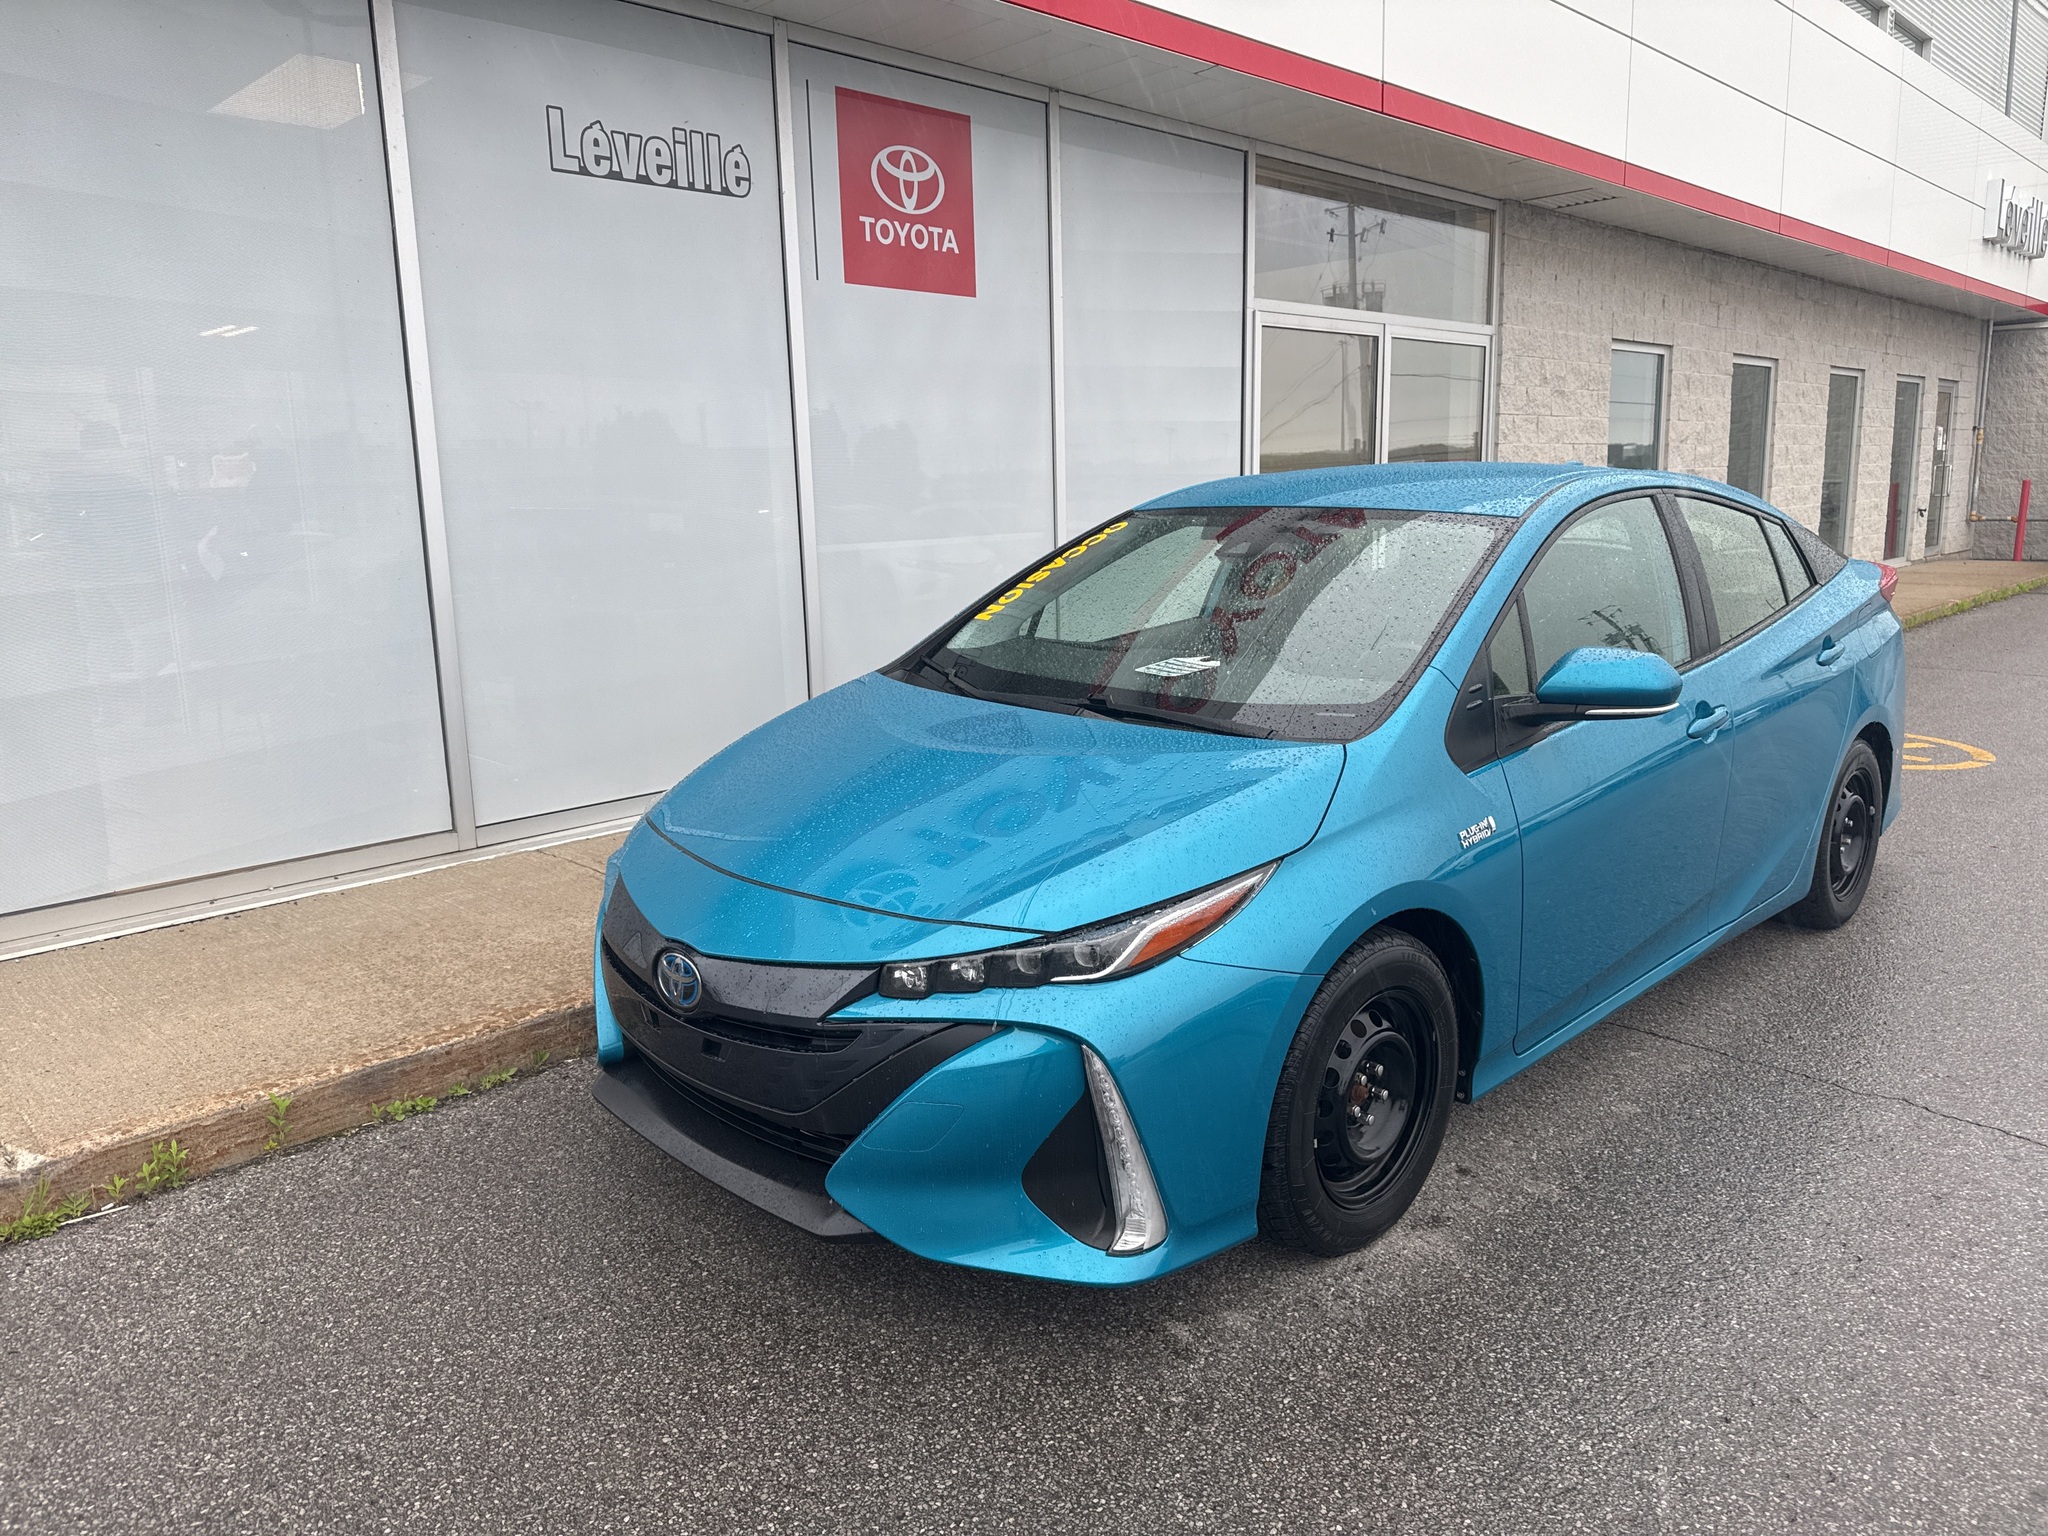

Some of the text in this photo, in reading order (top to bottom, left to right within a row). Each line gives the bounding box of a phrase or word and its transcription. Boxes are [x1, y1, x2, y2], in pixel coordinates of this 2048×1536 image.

[545, 105, 752, 199] Léveillé
[859, 215, 960, 255] TOYOTA
[974, 521, 1129, 621] OCCASION
[1461, 828, 1491, 849] HYBRID
